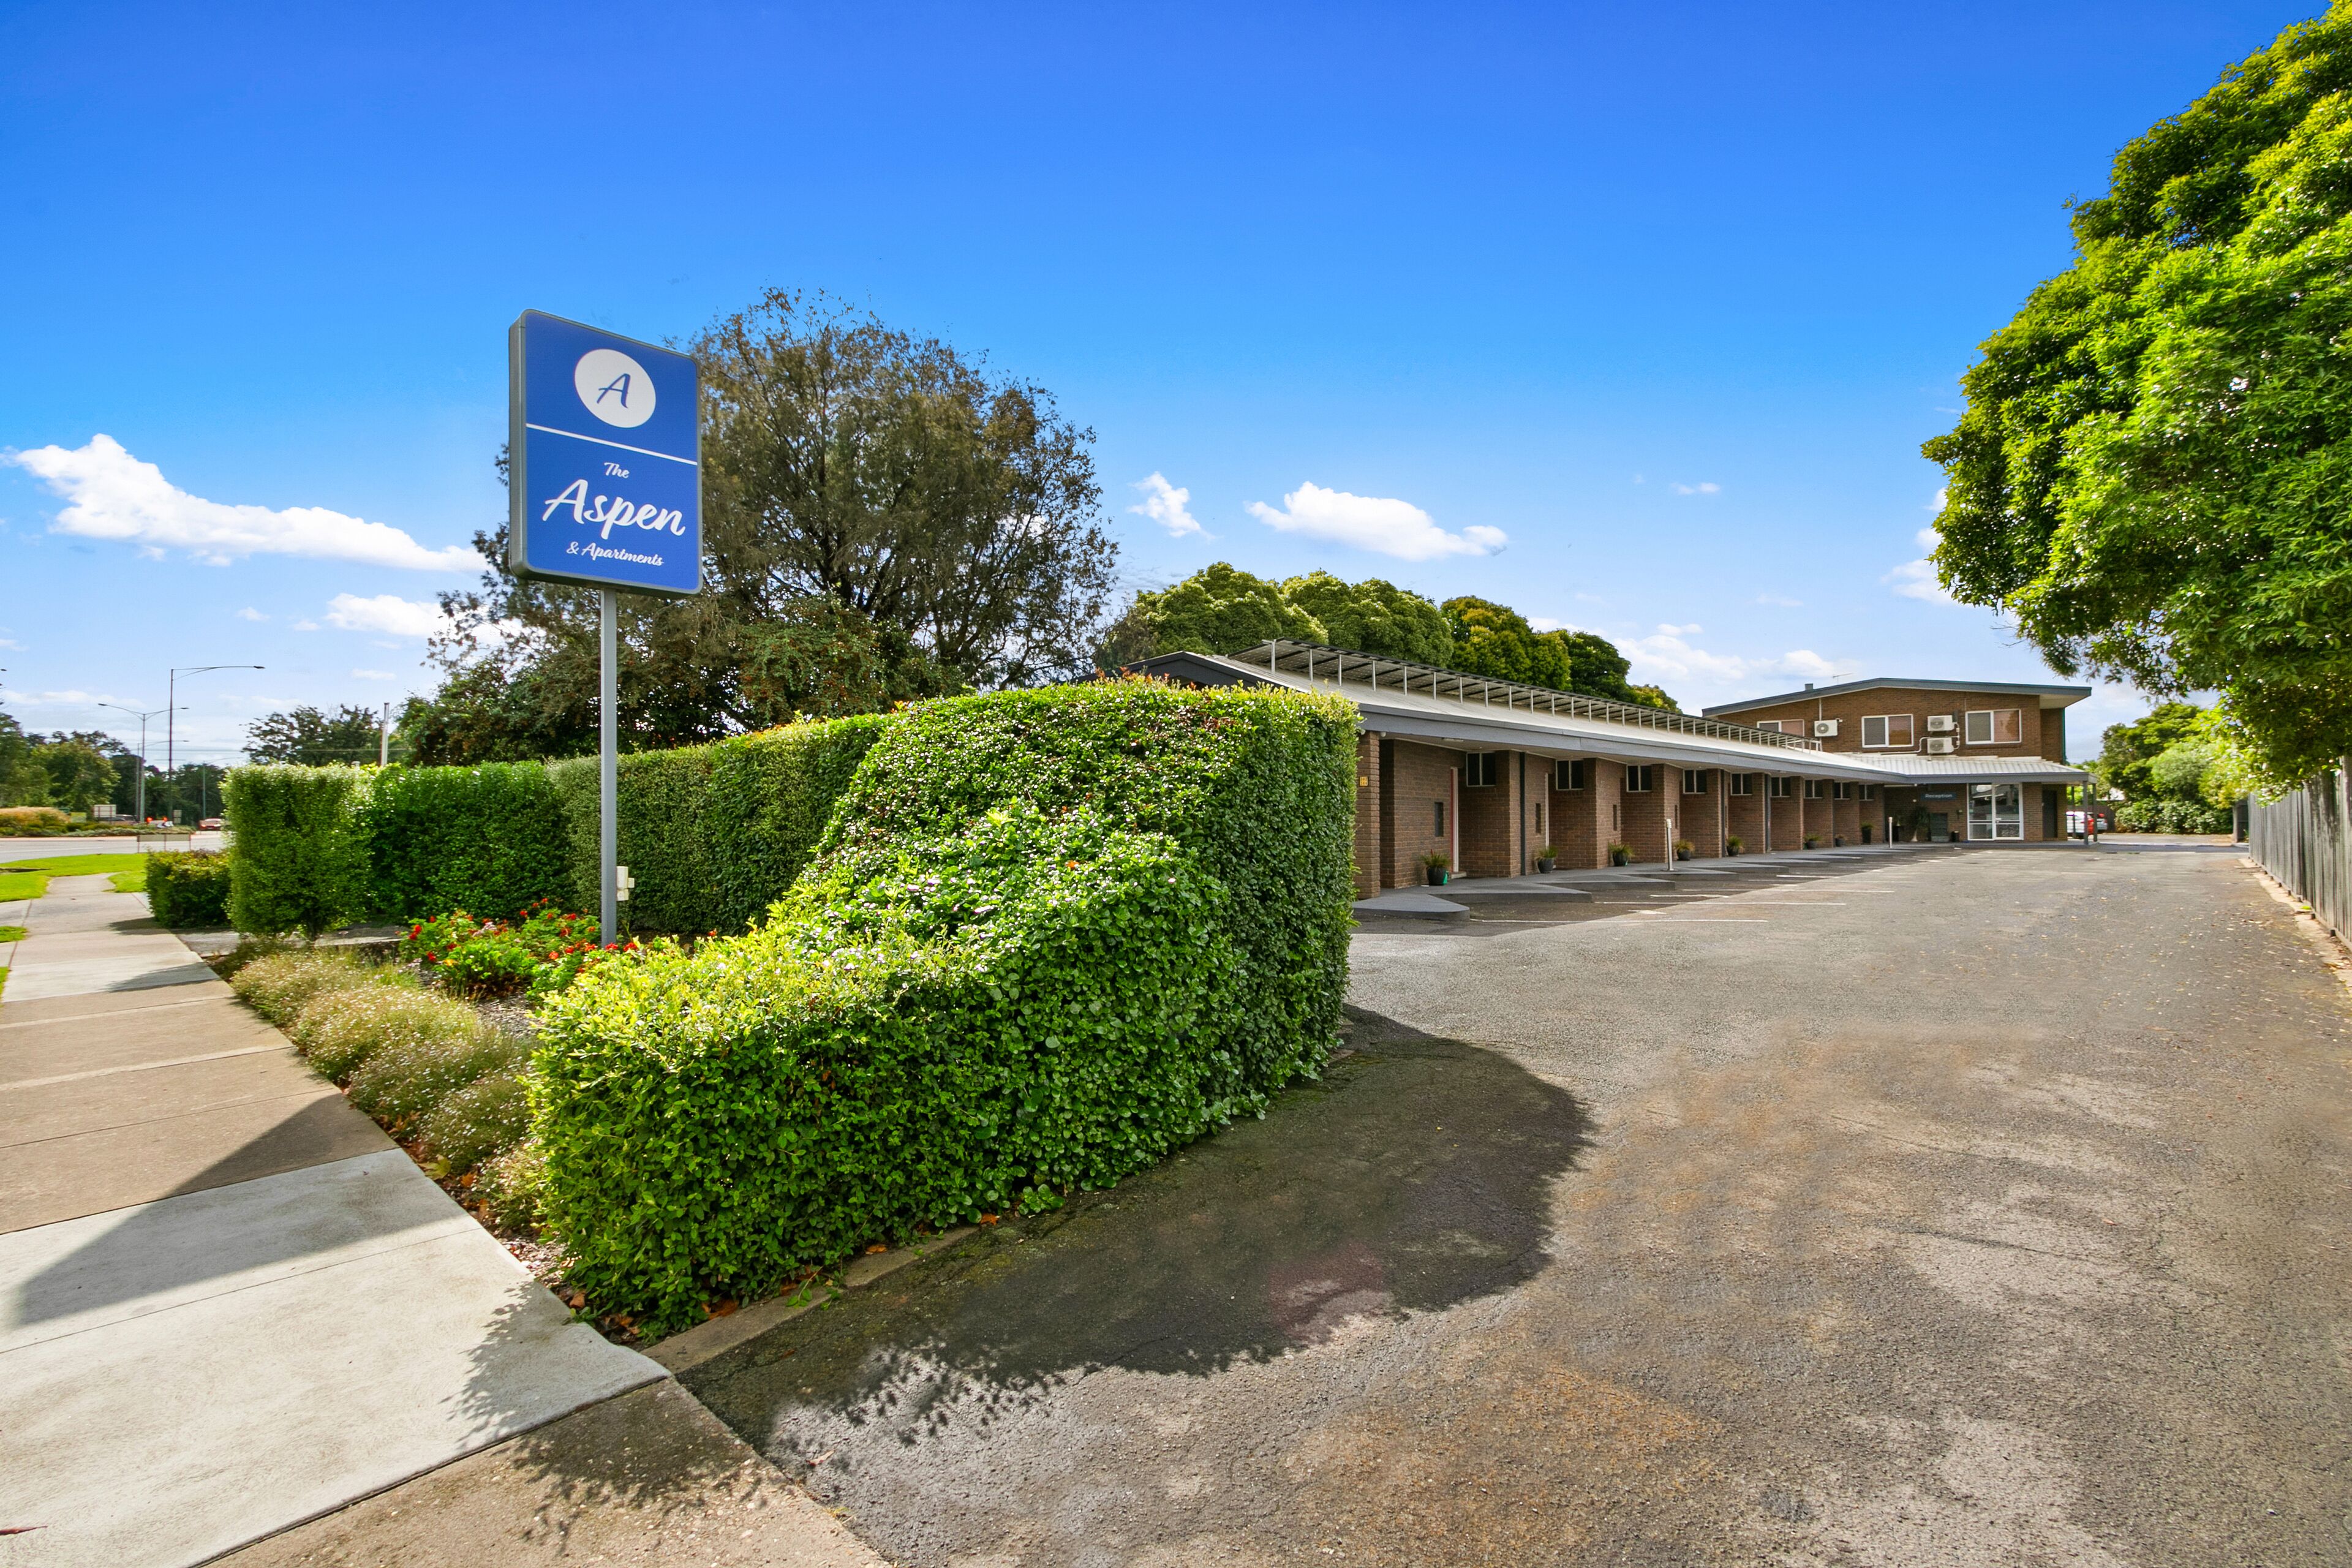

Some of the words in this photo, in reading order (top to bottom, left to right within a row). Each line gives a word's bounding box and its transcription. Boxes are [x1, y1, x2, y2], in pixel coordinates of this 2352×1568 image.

[597, 373, 631, 409] A
[604, 462, 630, 478] The
[542, 479, 686, 540] Aspen
[566, 541, 579, 555] &
[581, 542, 664, 566] Apartments
